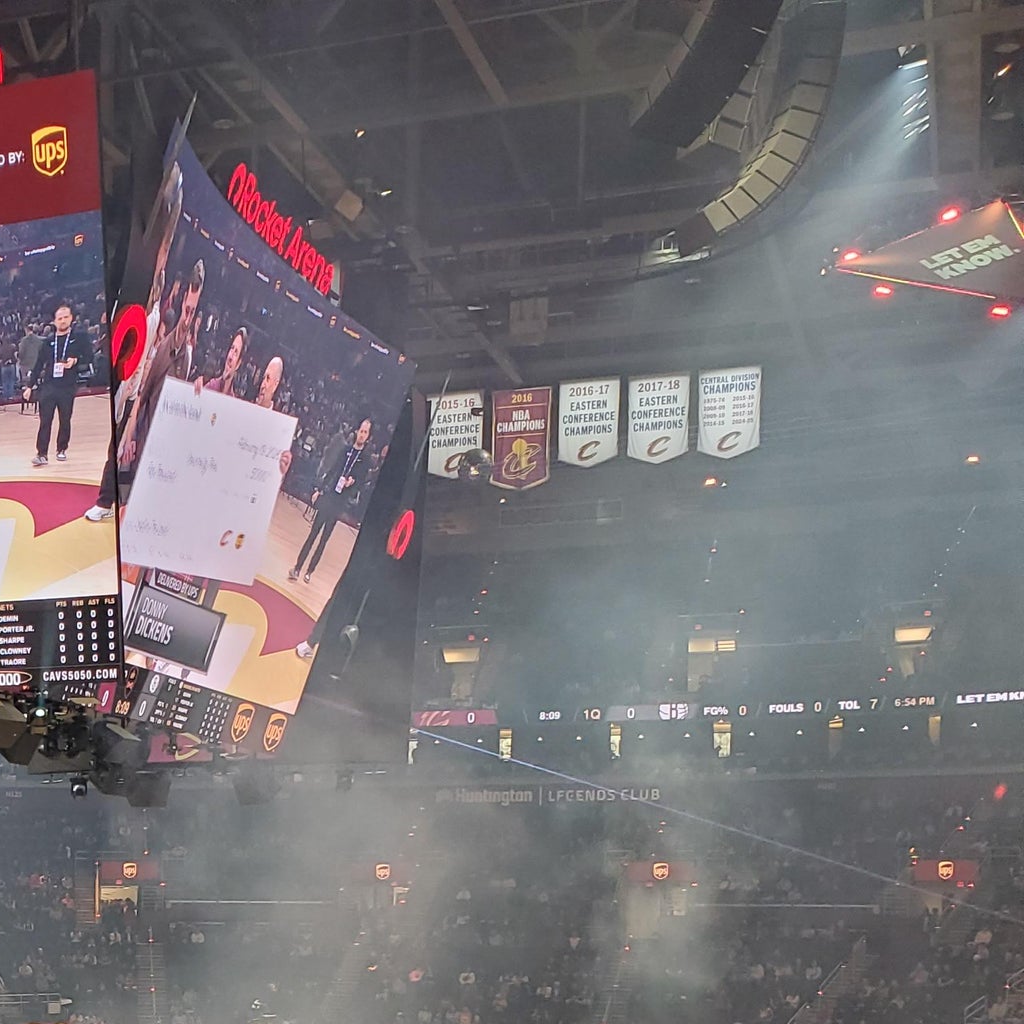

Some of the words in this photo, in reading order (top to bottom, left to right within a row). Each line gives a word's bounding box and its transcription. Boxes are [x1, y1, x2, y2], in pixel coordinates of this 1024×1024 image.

[8, 149, 26, 167] BY:
[237, 172, 293, 256] Rocket
[284, 226, 336, 296] Arena
[919, 247, 964, 270] LET
[960, 234, 1002, 254] EM
[933, 244, 1014, 280] KNOW
[638, 379, 680, 393] 2017-18
[700, 375, 729, 385] CENTRAL
[569, 384, 610, 397] 2016-17
[703, 380, 756, 395] CHAMPIONS
[436, 398, 475, 410] 2015-16
[511, 393, 533, 403] 2016
[639, 394, 678, 407] EASTERN
[570, 399, 608, 411] EASTERN
[437, 413, 472, 424] EASTERN
[512, 410, 530, 421] NBA
[562, 411, 616, 424] CONFERENCE
[631, 406, 686, 420] CONFERENCE
[430, 423, 480, 436] CONFERENCE
[496, 419, 545, 433] CHAMPIONS
[564, 424, 613, 437] CHAMPIONS
[633, 419, 684, 432] CHAMPIONS
[431, 436, 477, 448] CHAMPIONS
[142, 597, 169, 620] DONNY
[135, 616, 174, 646] DICKENS
[0, 636, 25, 644] SHARPE
[42, 668, 117, 682] CAVS5050.COM
[101, 690, 110, 707] 0
[838, 700, 860, 711] TOL
[870, 698, 878, 709] 7
[918, 695, 935, 706] PM
[956, 693, 986, 705] LET
[986, 692, 1009, 703] EM
[138, 700, 147, 717] 0
[627, 708, 635, 719] 0
[703, 705, 728, 716] FG%
[738, 705, 746, 716] 0
[769, 703, 804, 714] FOULS
[814, 701, 822, 712] 0
[466, 712, 475, 724] 0
[539, 710, 561, 721] 8:09
[583, 709, 601, 721] 1Q
[456, 788, 533, 806] Huntington
[620, 789, 660, 801] CLUB
